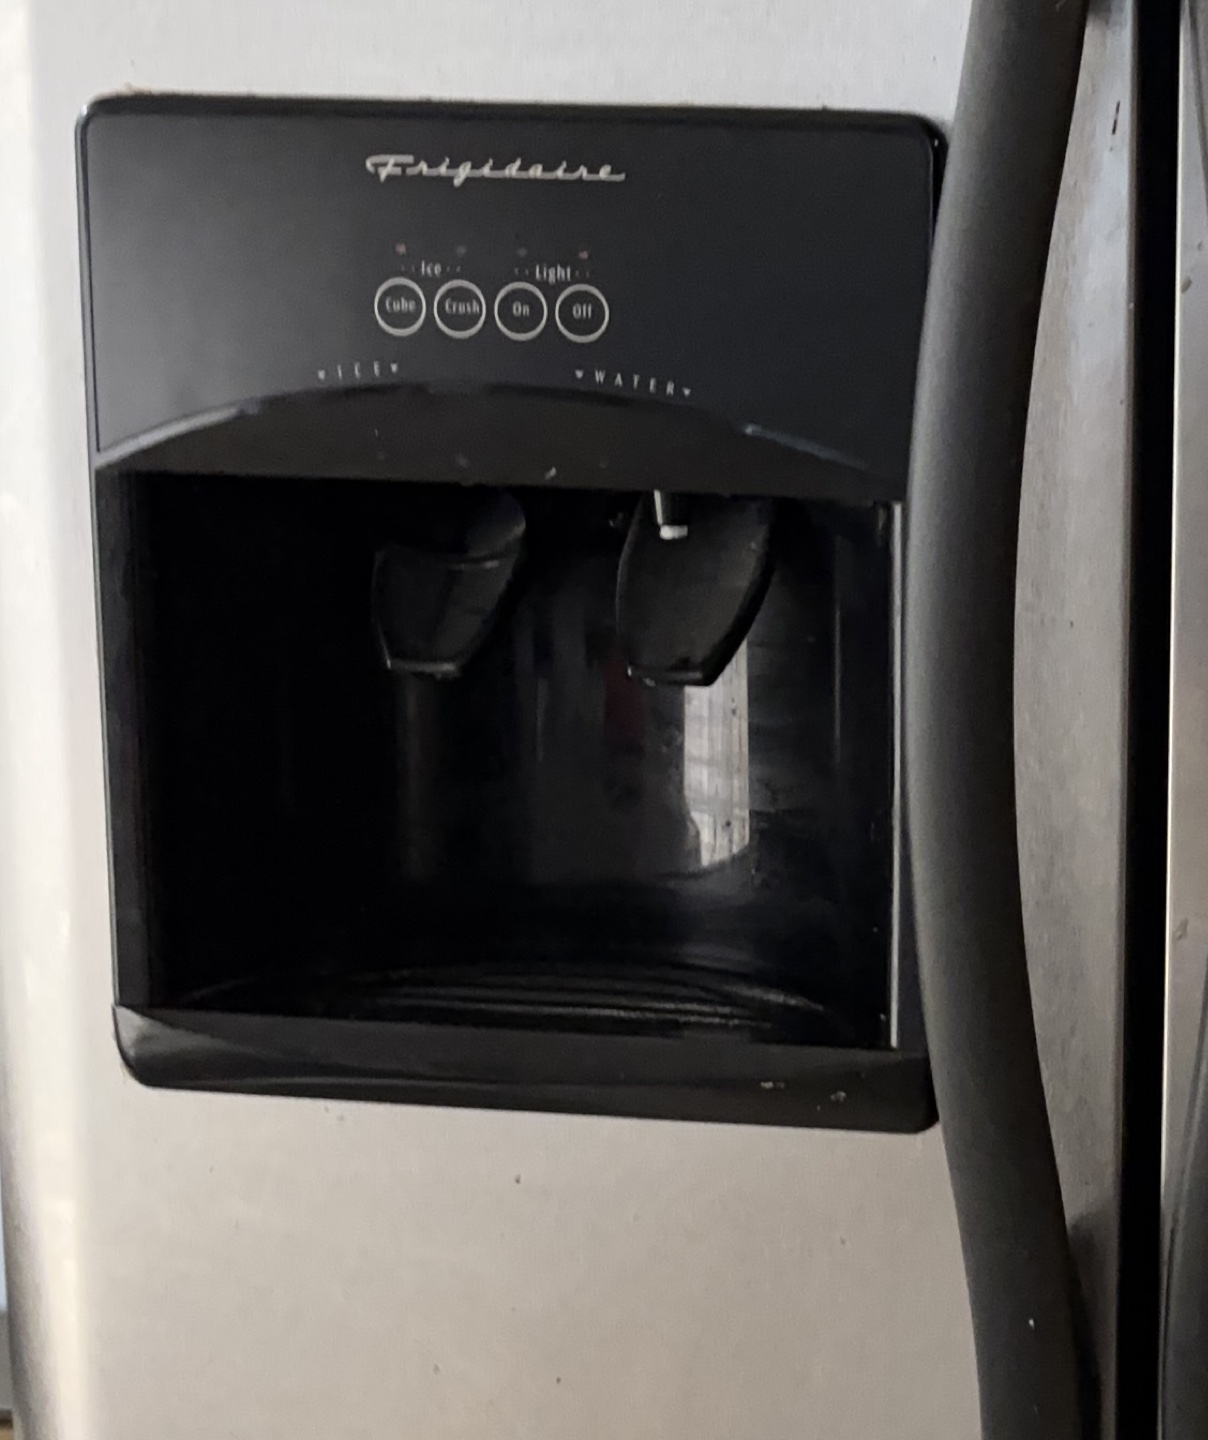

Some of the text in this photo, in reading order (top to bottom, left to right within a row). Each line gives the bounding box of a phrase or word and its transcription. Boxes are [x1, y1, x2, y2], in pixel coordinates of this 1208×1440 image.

[365, 154, 626, 187] Frigidaire
[420, 261, 442, 276] Ice
[535, 263, 571, 284] Light
[384, 297, 416, 313] Cube
[445, 299, 480, 315] Crush
[512, 302, 530, 317] On
[573, 303, 592, 320] Off
[338, 361, 381, 380] ICE
[594, 369, 675, 396] WATER
